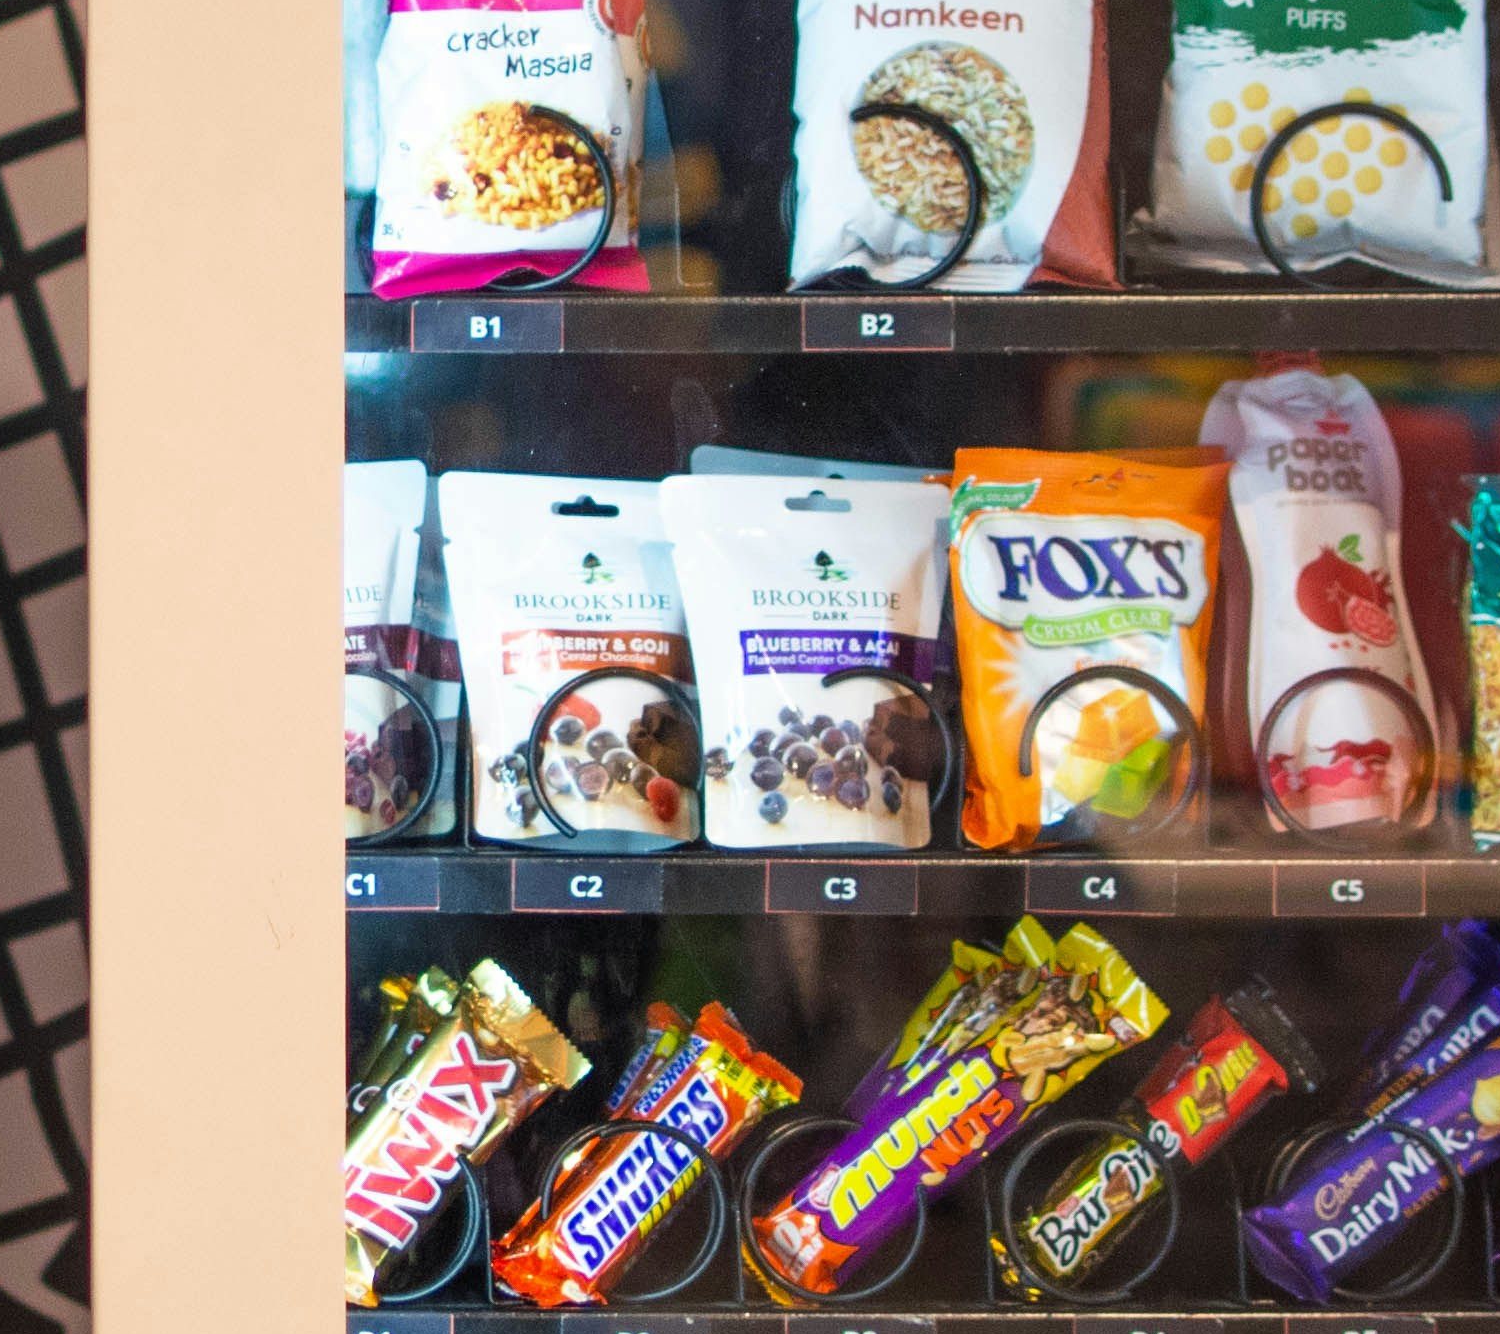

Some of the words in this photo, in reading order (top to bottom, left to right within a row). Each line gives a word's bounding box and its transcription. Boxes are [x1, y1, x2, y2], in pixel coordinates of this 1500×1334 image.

[854, 1, 1024, 33] Namkeen
[1286, 7, 1347, 32] PUFFS
[505, 52, 593, 78] Masala
[470, 316, 501, 338] B1
[860, 314, 895, 336] B2
[514, 593, 671, 611] BROOKSIDE
[752, 588, 902, 610] BROOKSIDE
[575, 613, 613, 623] DARK
[813, 610, 849, 622] DARK
[1031, 618, 1105, 640] CRYSTAL
[1108, 609, 1164, 631] CLEAR
[629, 638, 671, 656] GOJI
[746, 637, 845, 655] BLUEBERRY
[345, 873, 377, 897] C1
[570, 875, 603, 899] C2
[824, 878, 857, 901] C3
[1081, 877, 1117, 900] C4
[1330, 879, 1365, 902] C5
[345, 1030, 517, 1250] TWIX
[828, 1056, 999, 1230] munch
[920, 1088, 1017, 1179] NUTS
[561, 1075, 729, 1277] SNICKERS
[1030, 1192, 1109, 1274] Bar
[1308, 1187, 1402, 1264] Dairy
